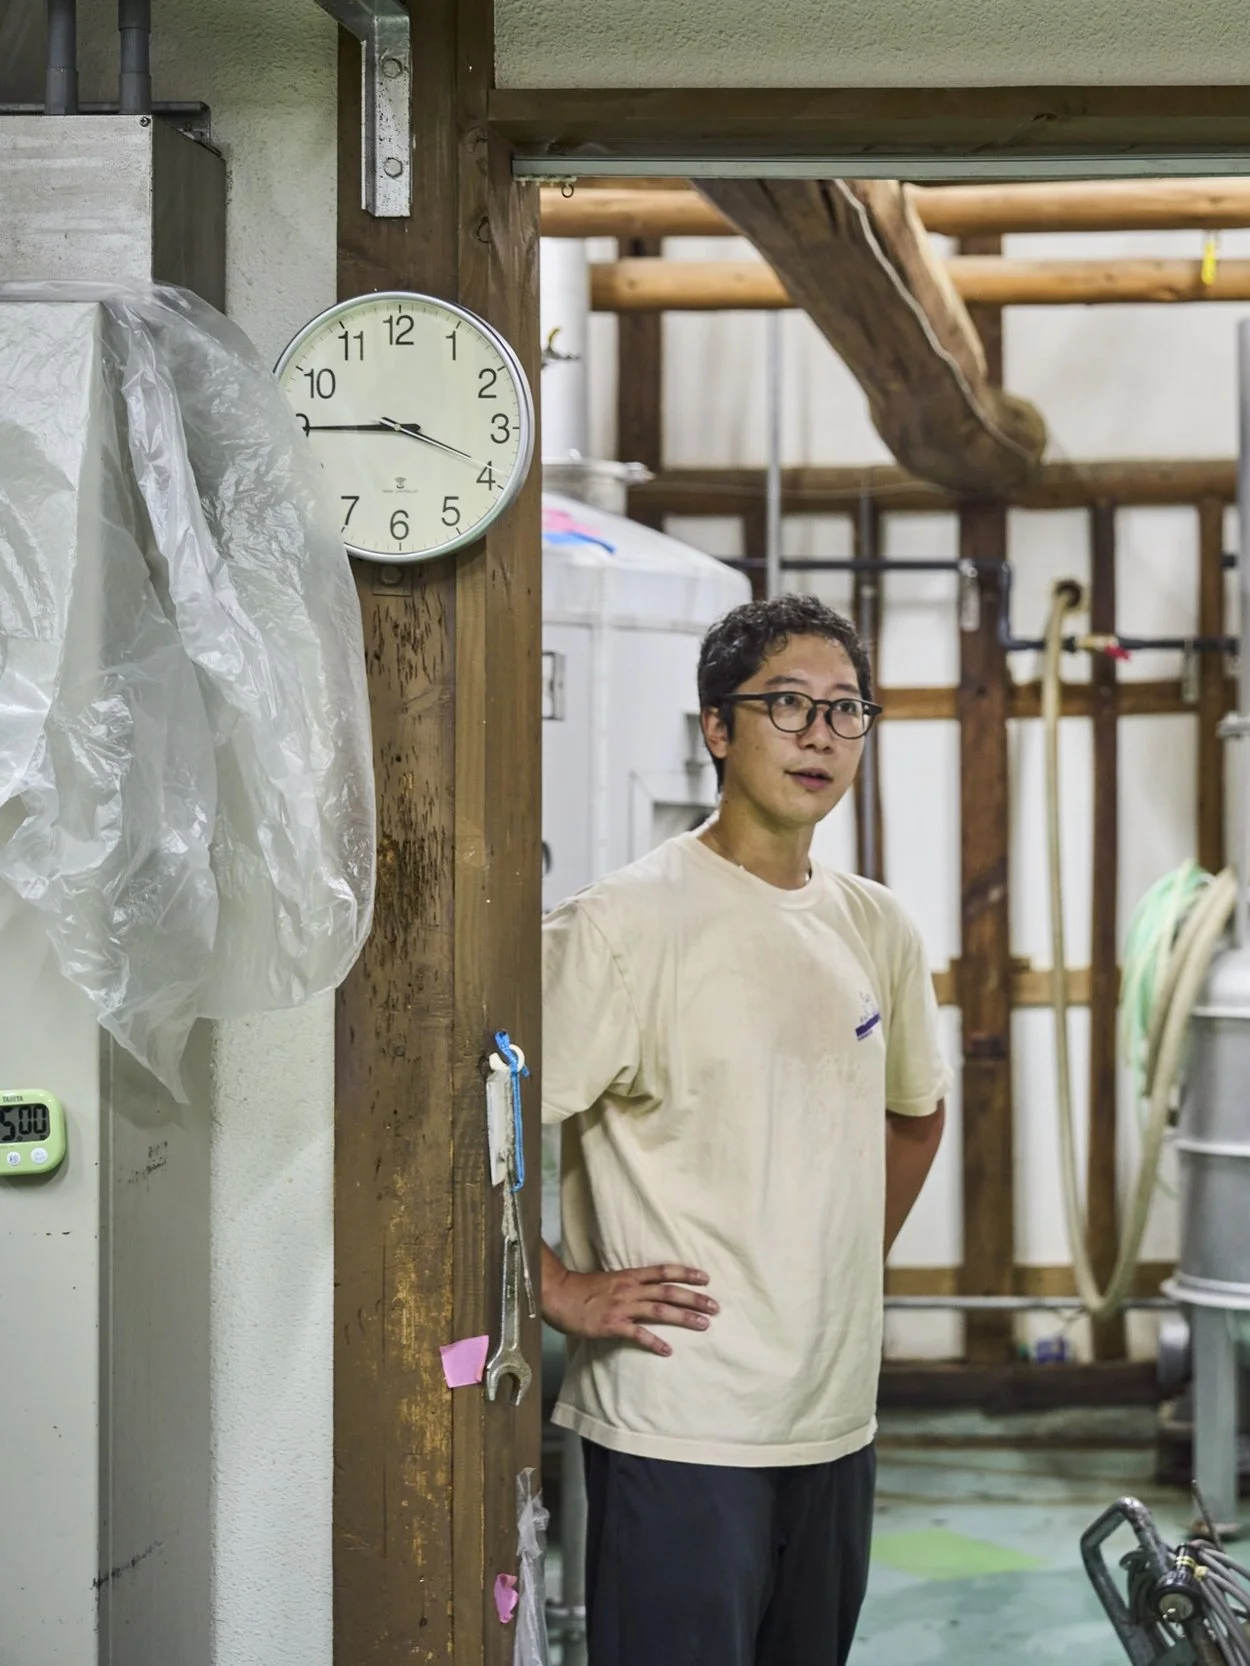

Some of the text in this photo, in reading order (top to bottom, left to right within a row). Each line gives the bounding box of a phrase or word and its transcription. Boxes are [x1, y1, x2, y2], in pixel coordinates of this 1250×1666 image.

[382, 315, 415, 345] 12
[338, 331, 364, 361] 11
[445, 331, 456, 361] 1
[303, 368, 336, 399] 10
[478, 368, 497, 399] 2
[490, 413, 510, 444] 3
[476, 461, 496, 491] 4
[341, 495, 360, 526] 7
[390, 509, 409, 540] 6
[441, 496, 461, 527] 5
